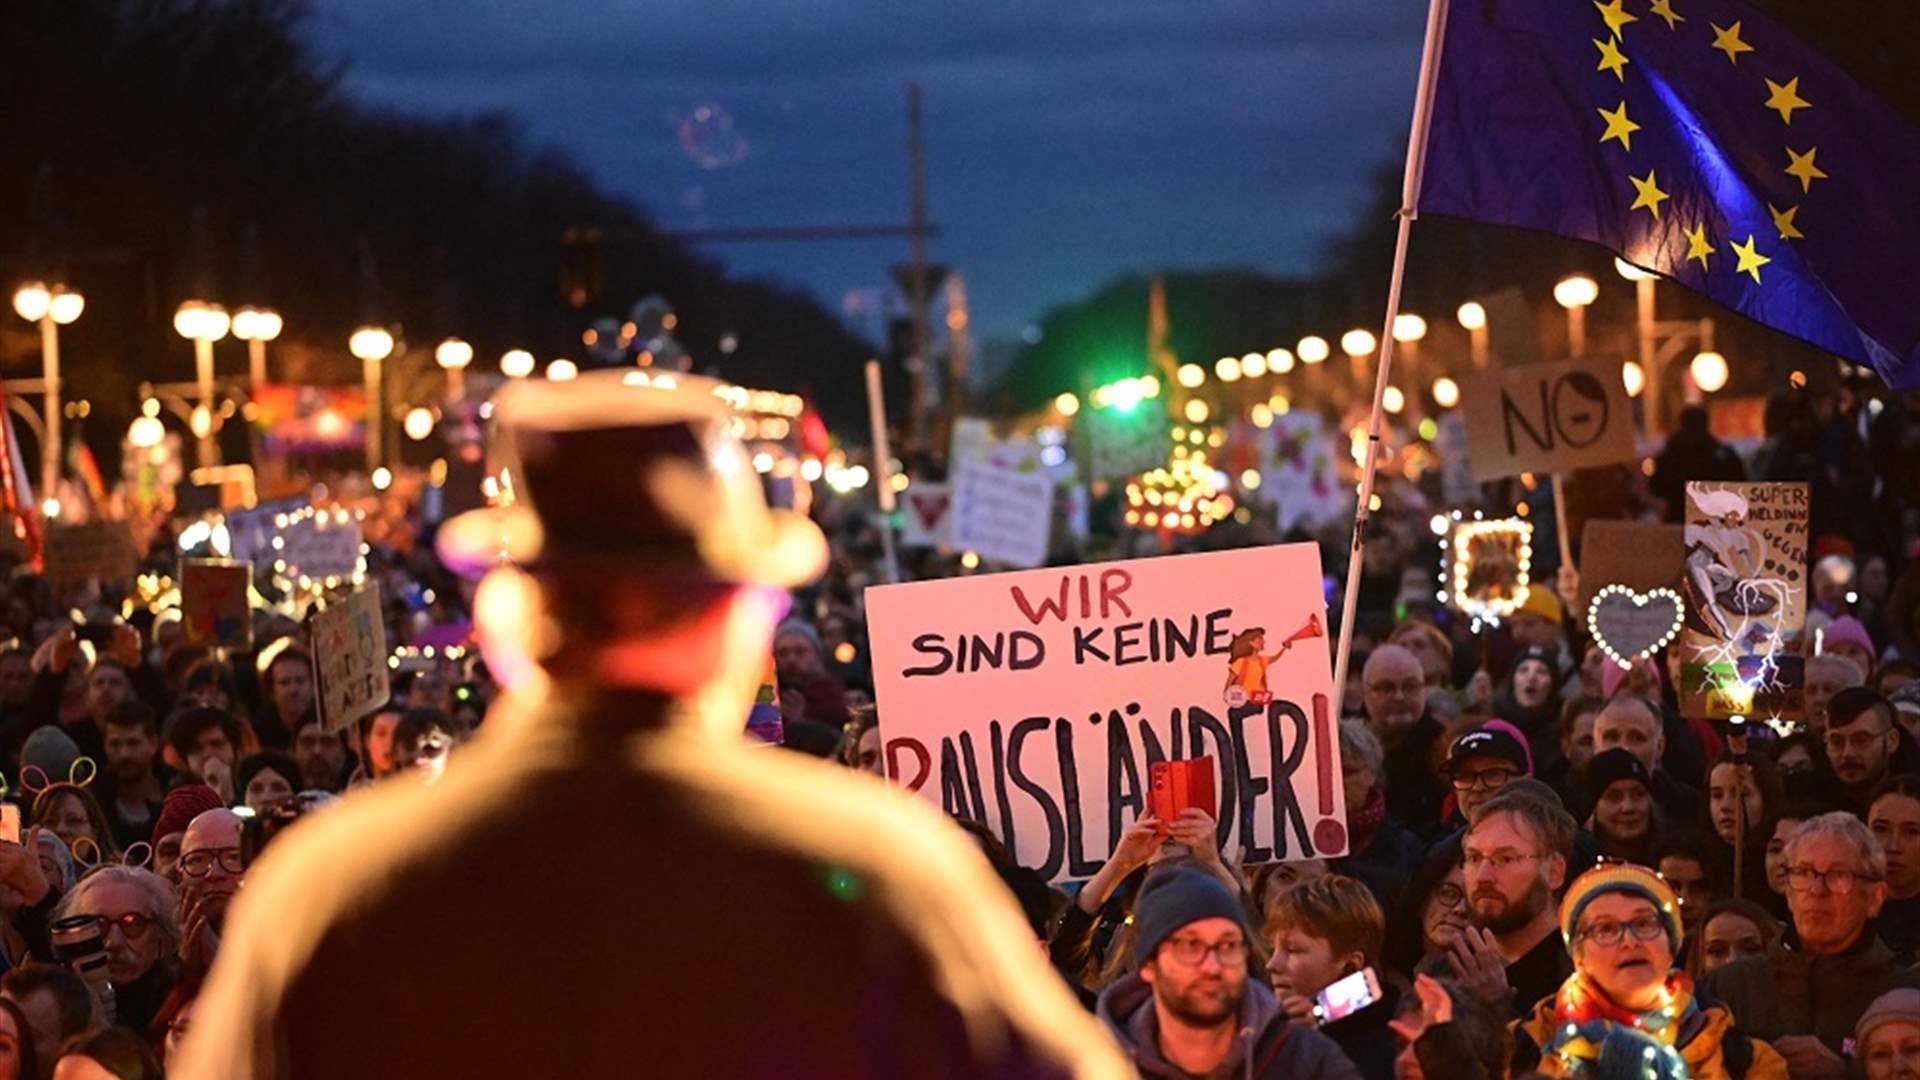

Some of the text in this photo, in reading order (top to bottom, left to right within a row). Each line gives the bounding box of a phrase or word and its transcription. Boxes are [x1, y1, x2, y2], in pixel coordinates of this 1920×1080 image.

[1501, 371, 1609, 456] NO
[1010, 568, 1133, 625] WIR
[902, 608, 1233, 678] SIND KEINE
